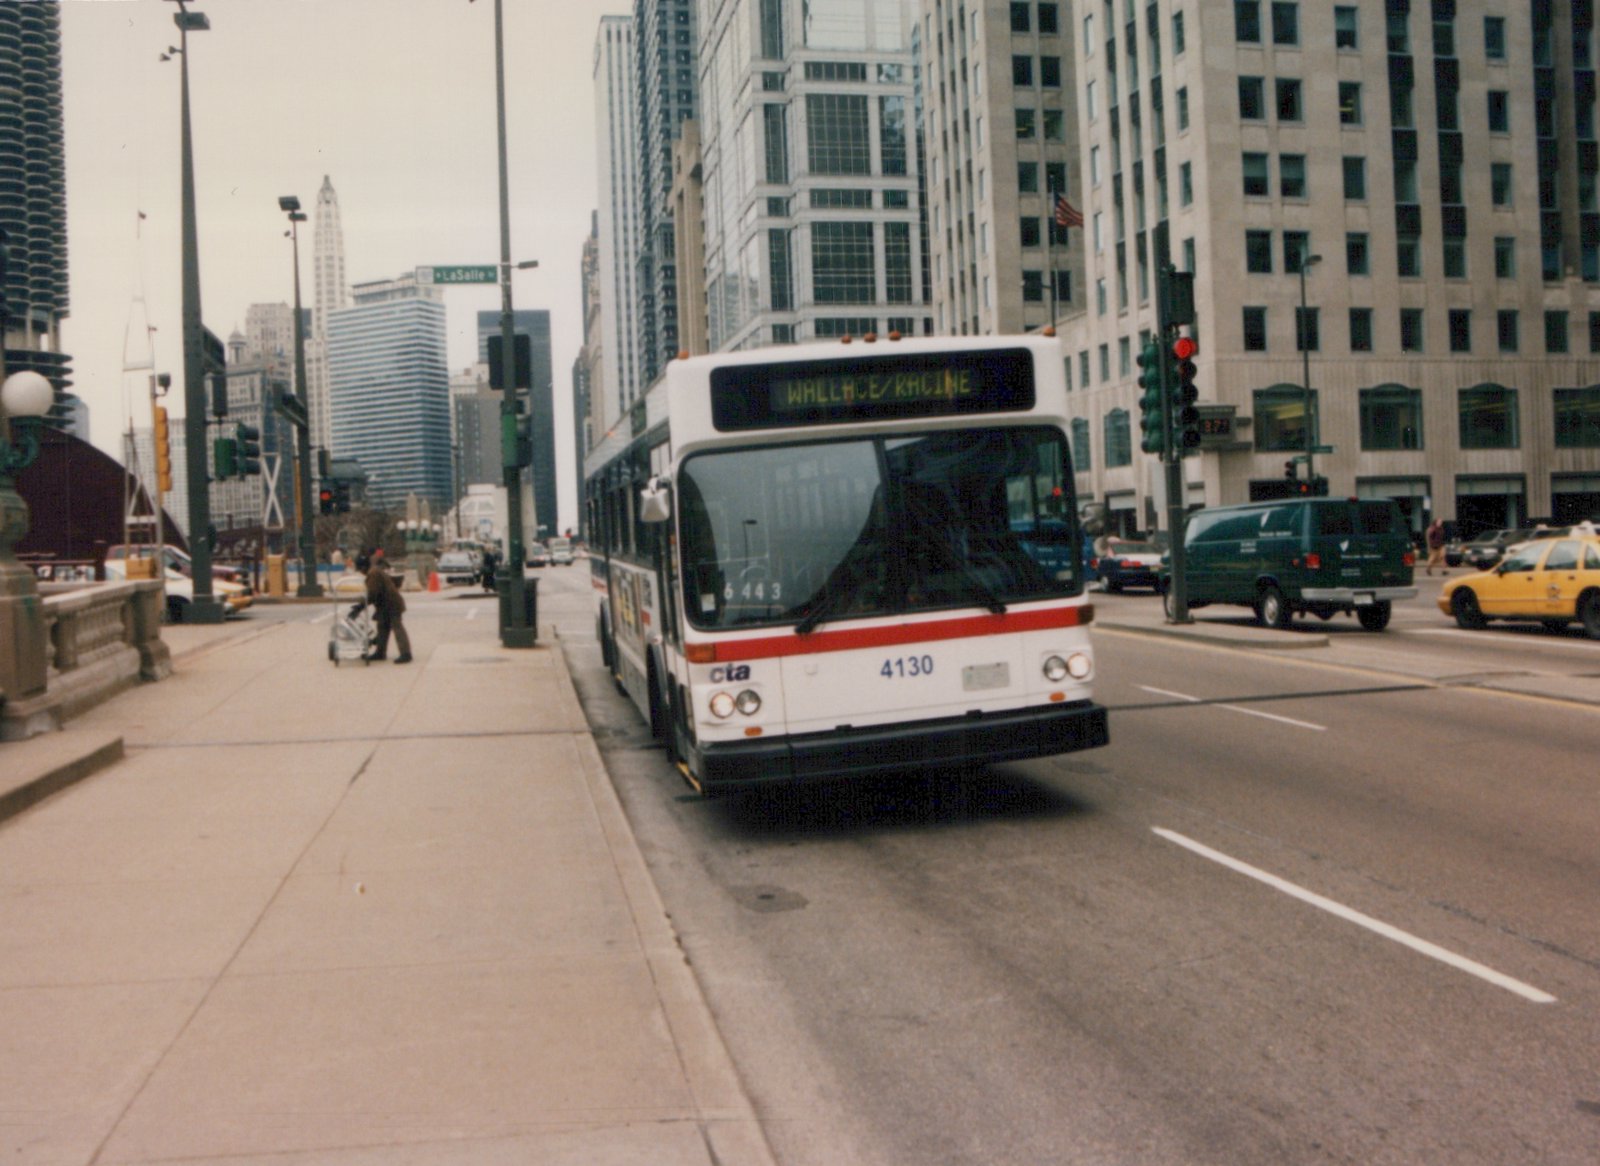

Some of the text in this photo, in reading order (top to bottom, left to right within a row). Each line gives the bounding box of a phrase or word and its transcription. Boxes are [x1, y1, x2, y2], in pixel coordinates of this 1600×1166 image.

[442, 269, 485, 281] LaSalle
[709, 662, 751, 684] cta
[880, 654, 933, 679] 4130
